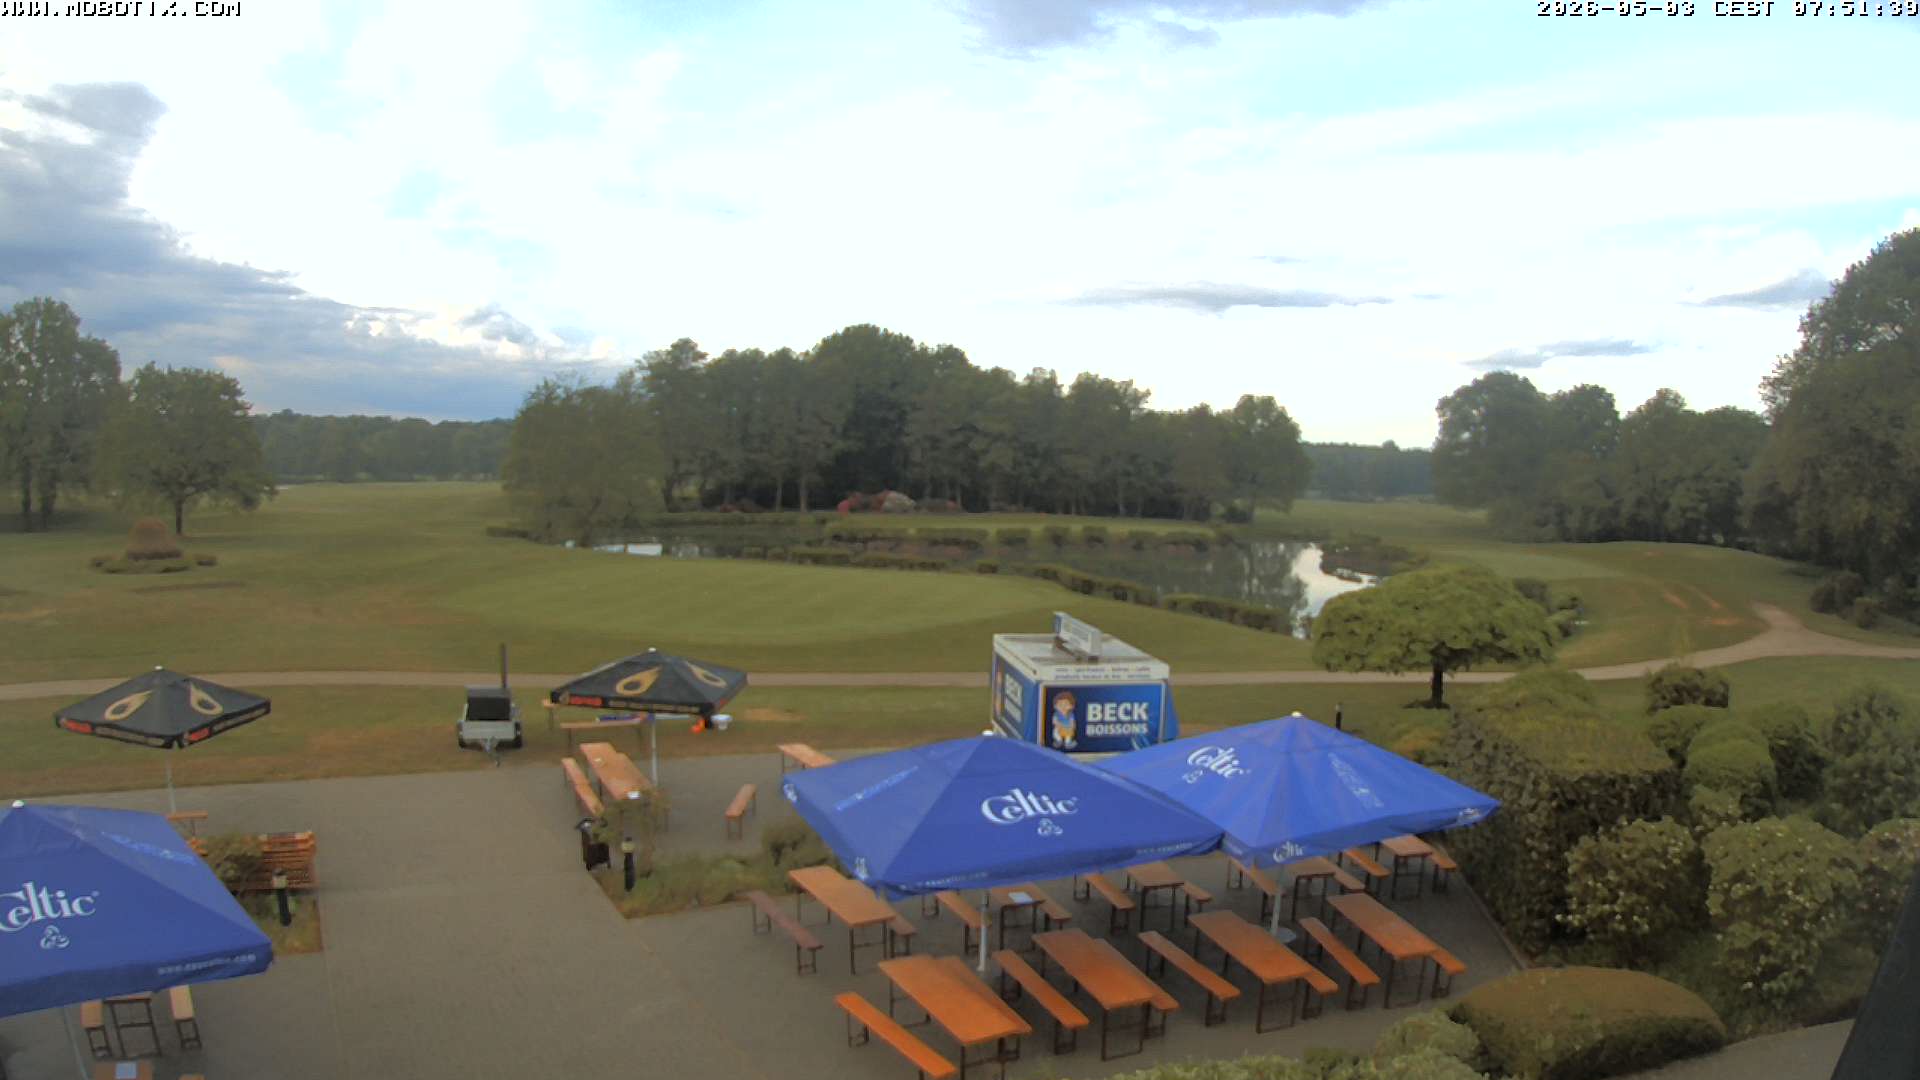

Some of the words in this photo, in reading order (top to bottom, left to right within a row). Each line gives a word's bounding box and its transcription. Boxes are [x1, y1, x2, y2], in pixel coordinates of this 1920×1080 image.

[1086, 701, 1149, 723] BECK
[1086, 722, 1148, 737] BOISSONS
[1187, 745, 1245, 778] Celtic
[981, 787, 1077, 825] Celtic
